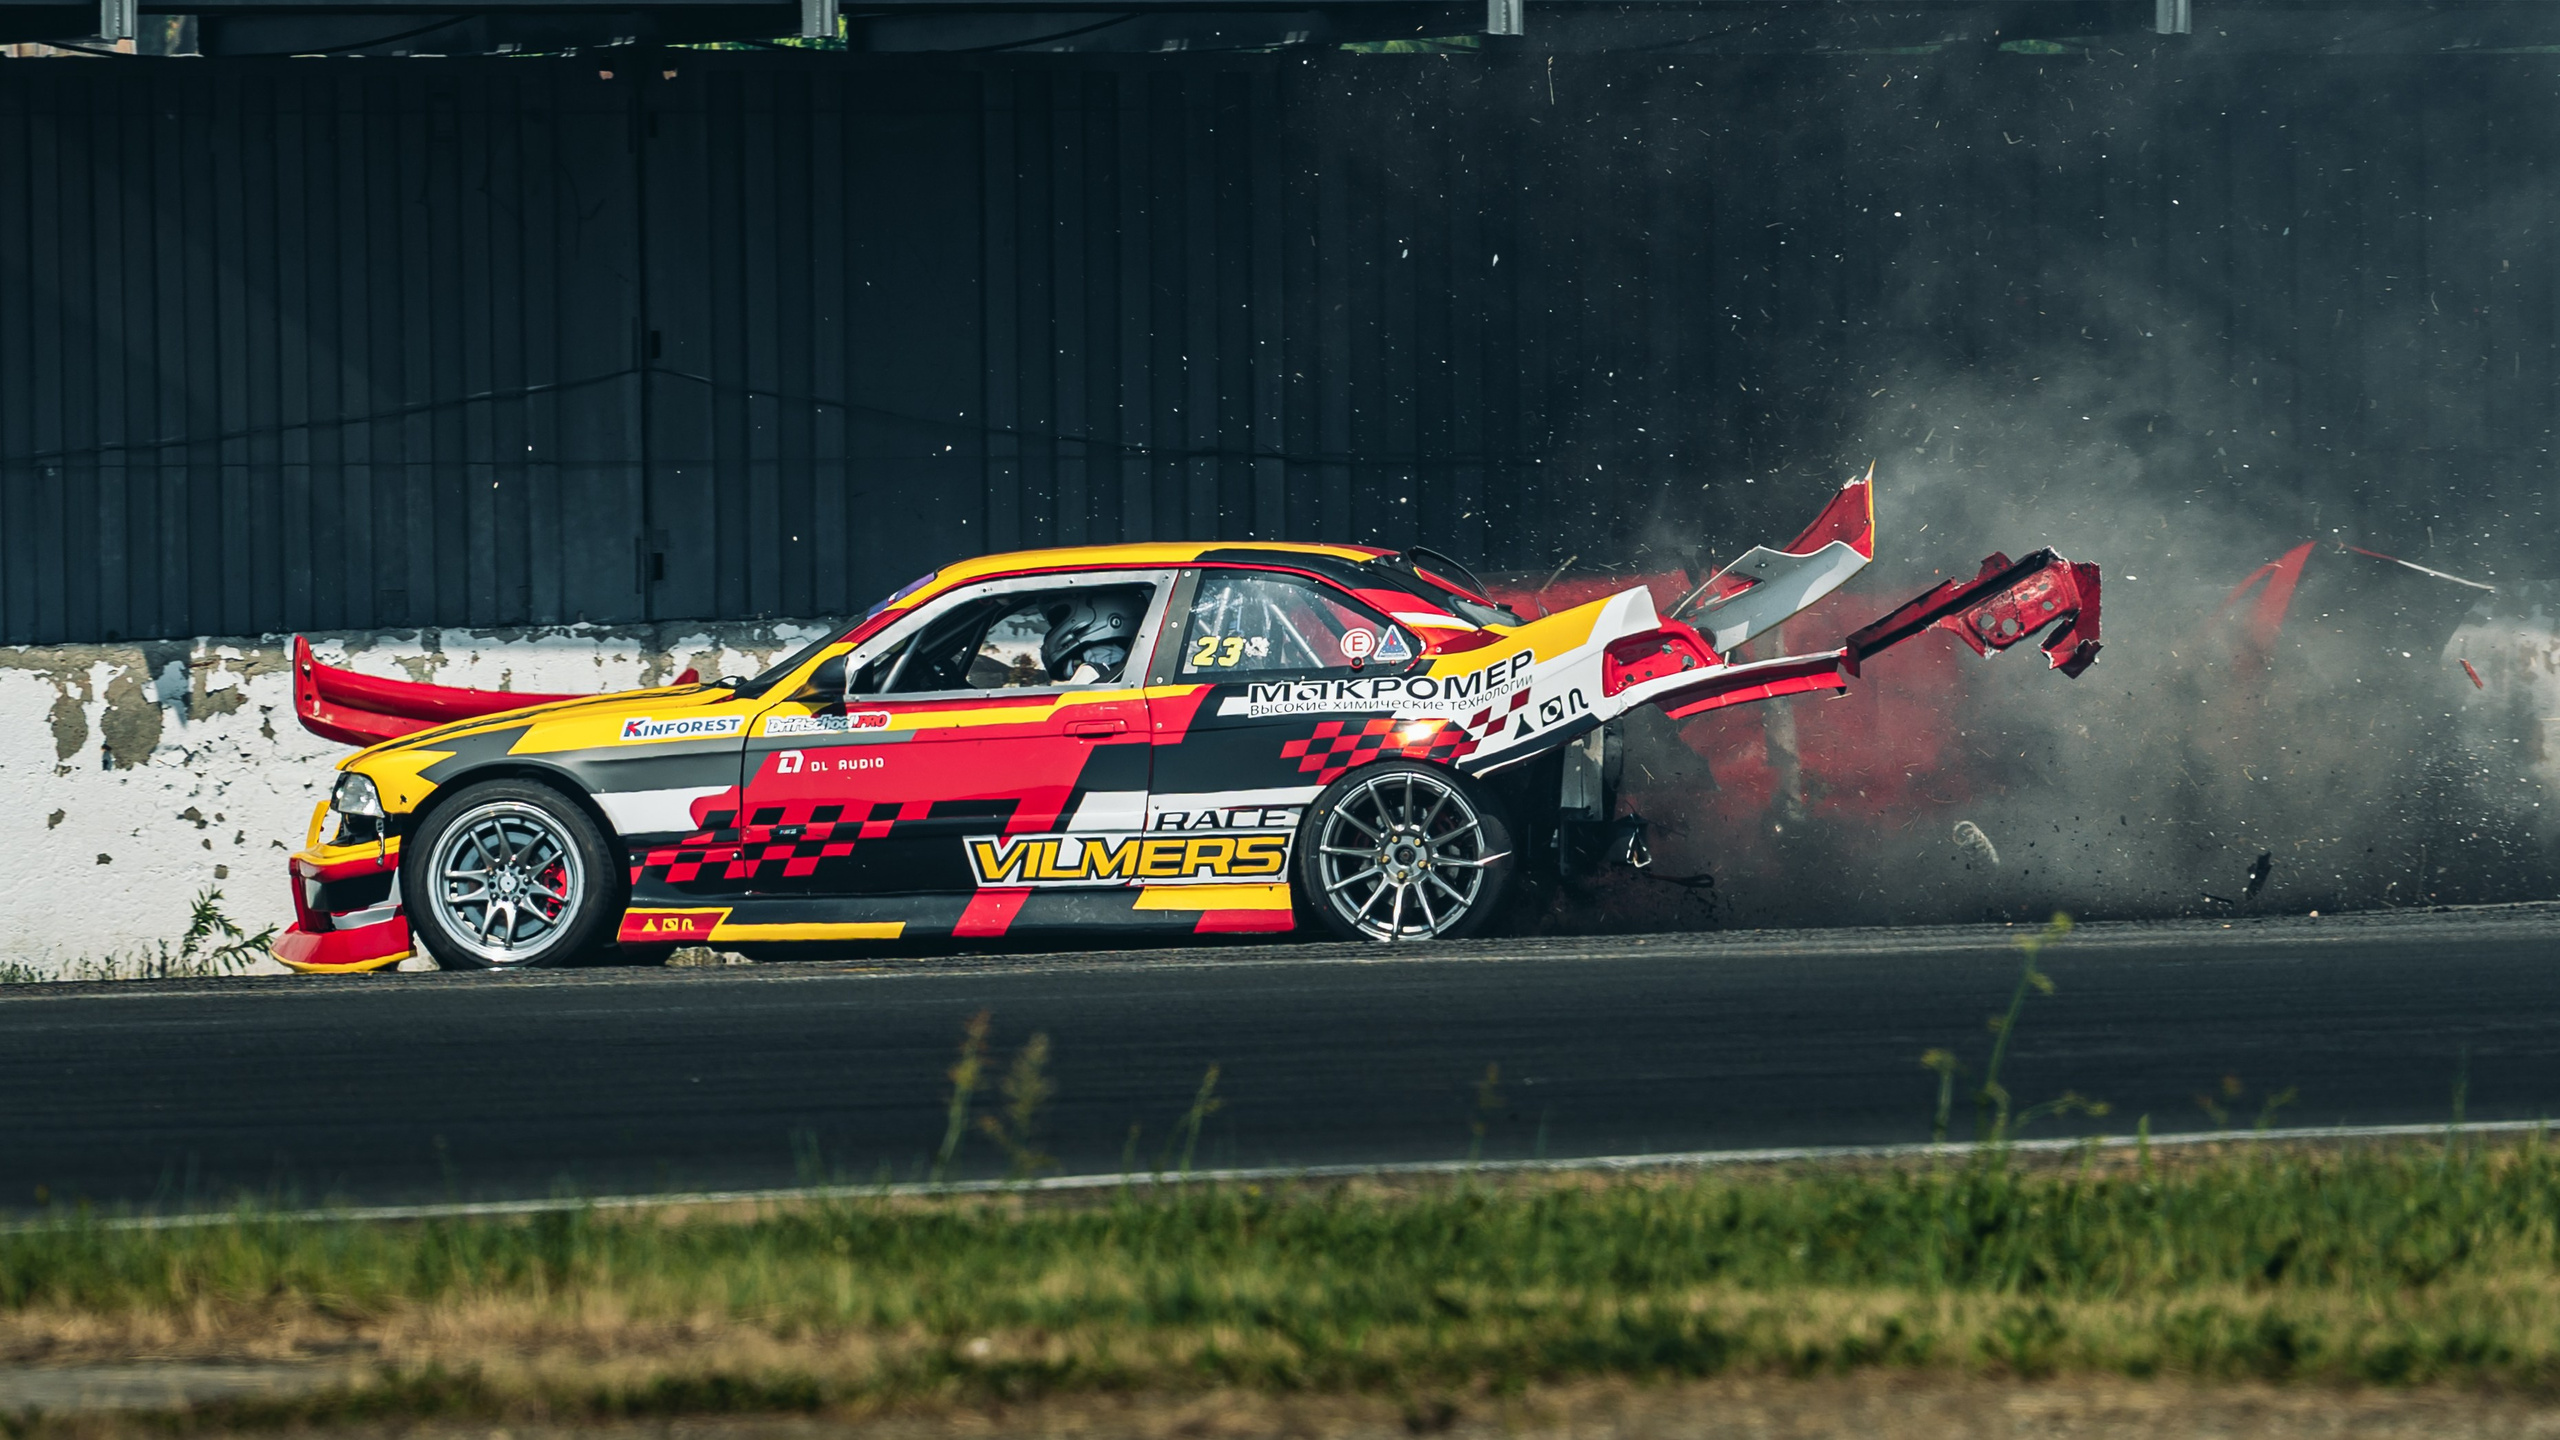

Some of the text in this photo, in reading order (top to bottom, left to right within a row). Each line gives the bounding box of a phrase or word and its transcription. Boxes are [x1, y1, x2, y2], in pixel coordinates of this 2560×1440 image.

[1192, 636, 1245, 667] 23
[1352, 635, 1364, 652] E
[1333, 699, 1444, 711] химические
[1450, 674, 1533, 711] технологии
[623, 719, 740, 738] KINFOREST
[810, 757, 884, 772] DL AUDIO
[1154, 807, 1289, 832] RACE
[970, 834, 1289, 882] VILMERS
